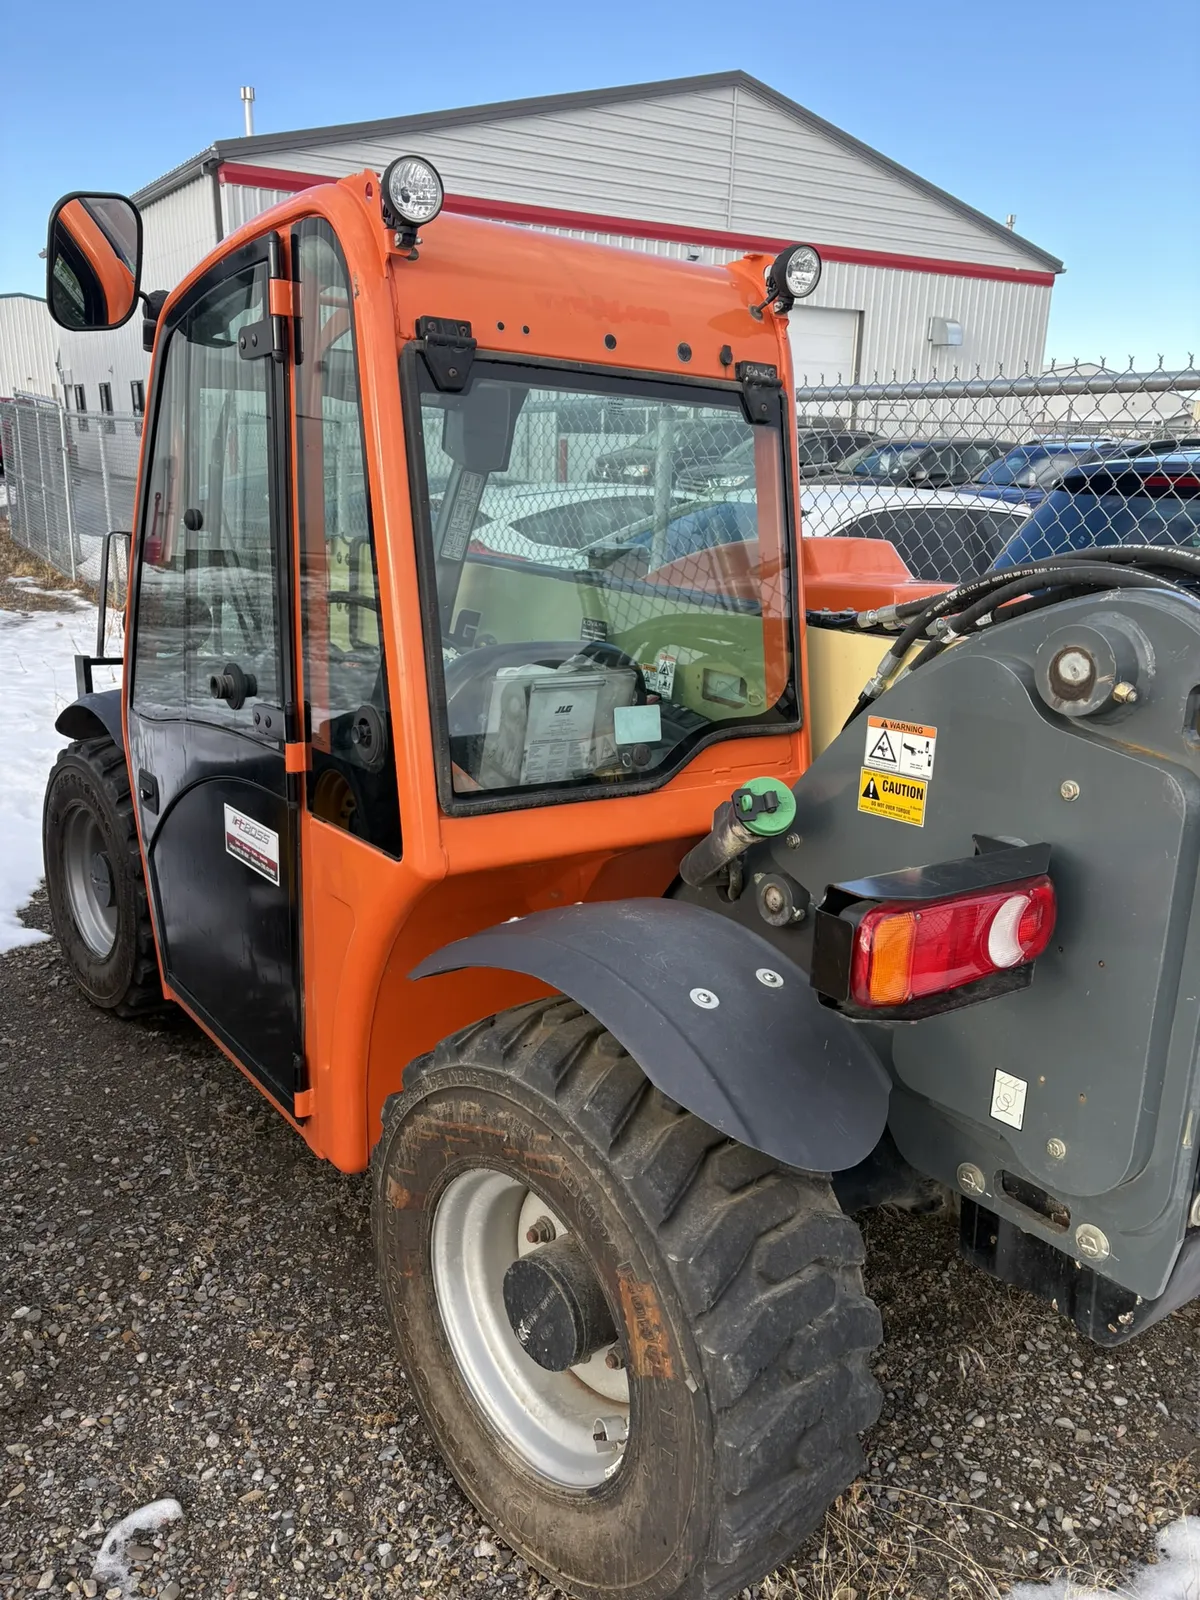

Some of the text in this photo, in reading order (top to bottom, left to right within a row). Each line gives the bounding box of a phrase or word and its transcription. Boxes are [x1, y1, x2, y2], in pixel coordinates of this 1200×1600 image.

[555, 704, 574, 714] JLG
[890, 721, 924, 735] WARNING
[882, 779, 924, 801] CAUTION
[896, 806, 911, 815] TORQUE
